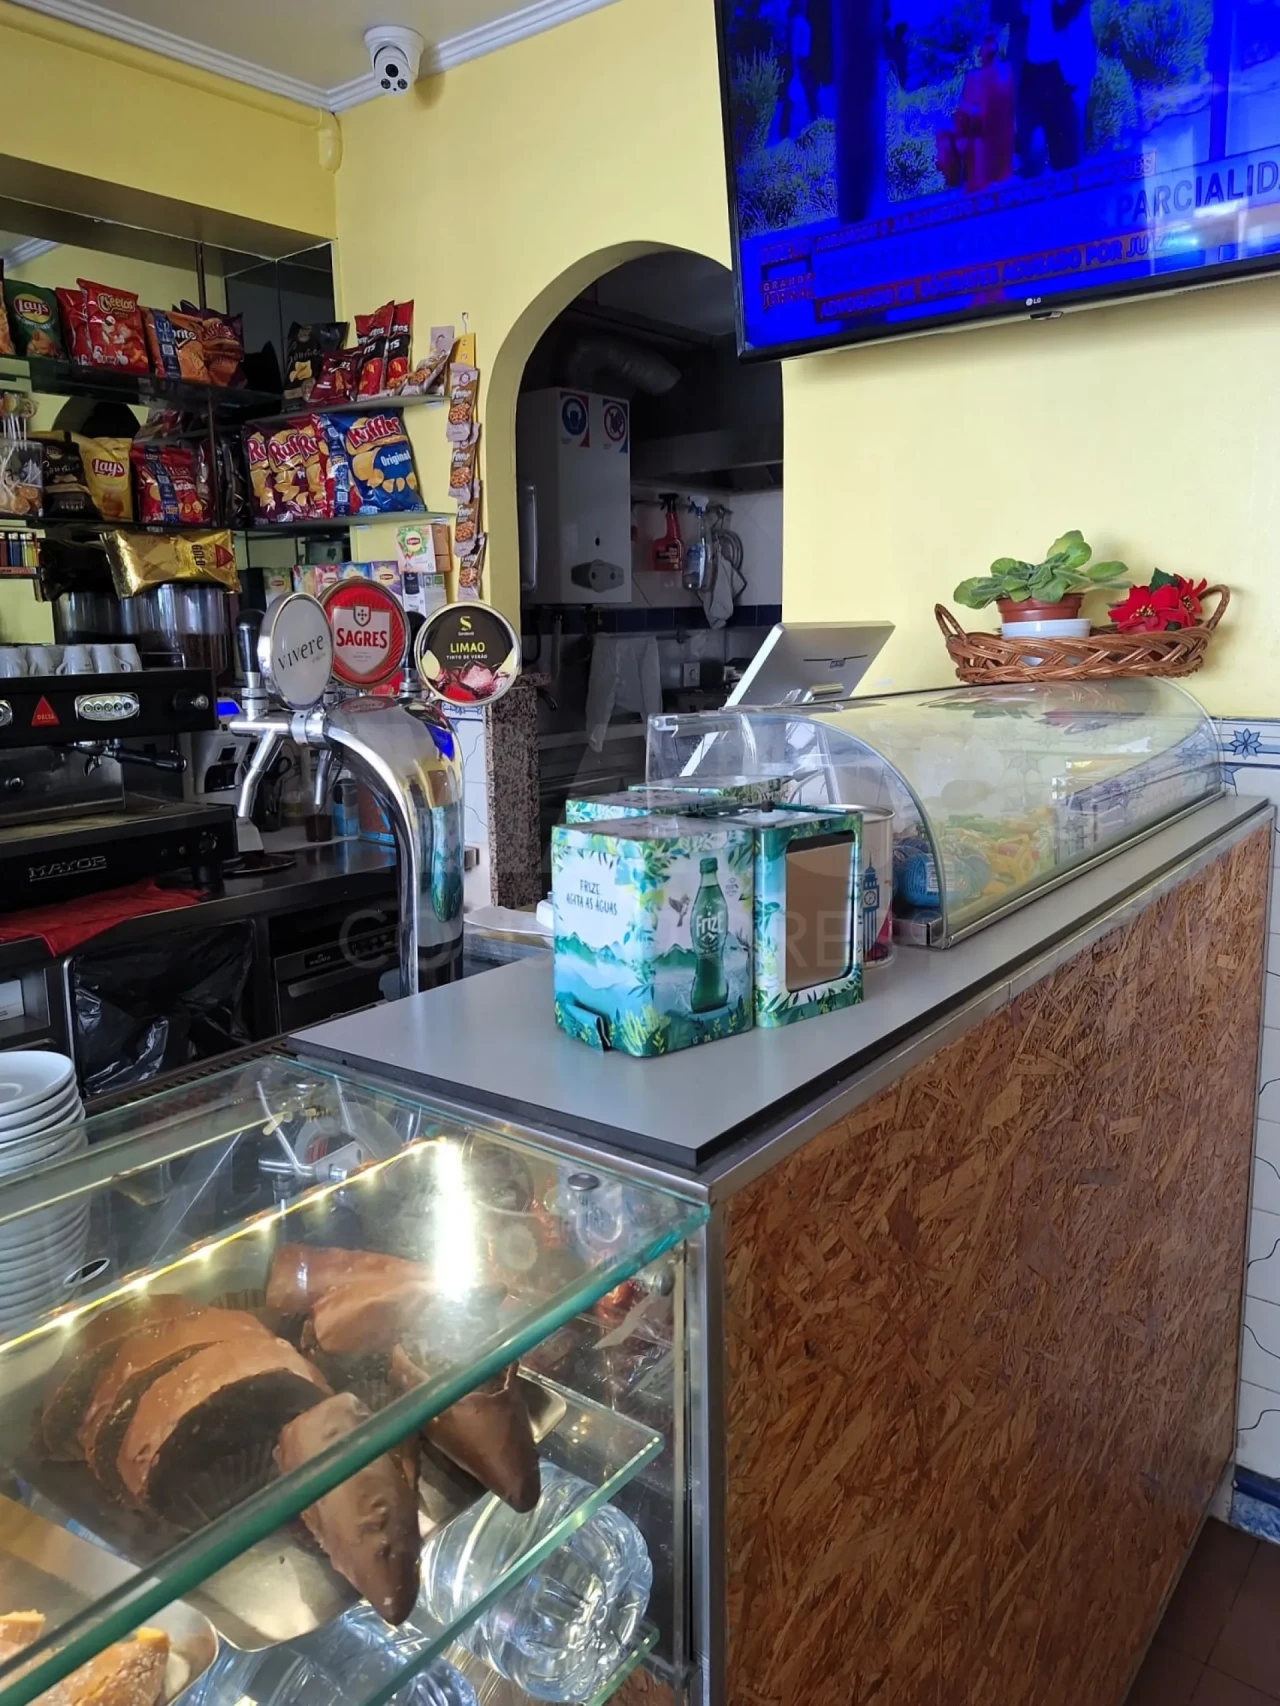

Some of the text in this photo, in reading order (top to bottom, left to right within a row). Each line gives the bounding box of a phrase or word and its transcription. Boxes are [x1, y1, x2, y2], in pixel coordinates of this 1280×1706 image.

[1116, 159, 1280, 222] PARCIALID
[1085, 239, 1123, 265] POR
[763, 272, 814, 292] GRANDE
[98, 294, 135, 313] Cheetos
[347, 414, 402, 448] Ruffles
[380, 449, 412, 467] Original
[191, 544, 206, 566] GOLD
[336, 627, 388, 649] SAGRES
[277, 634, 324, 671] vivere
[37, 712, 56, 721] DELTA
[29, 855, 108, 880] MAYOR
[580, 879, 601, 895] FRIZE
[585, 897, 594, 910] AS
